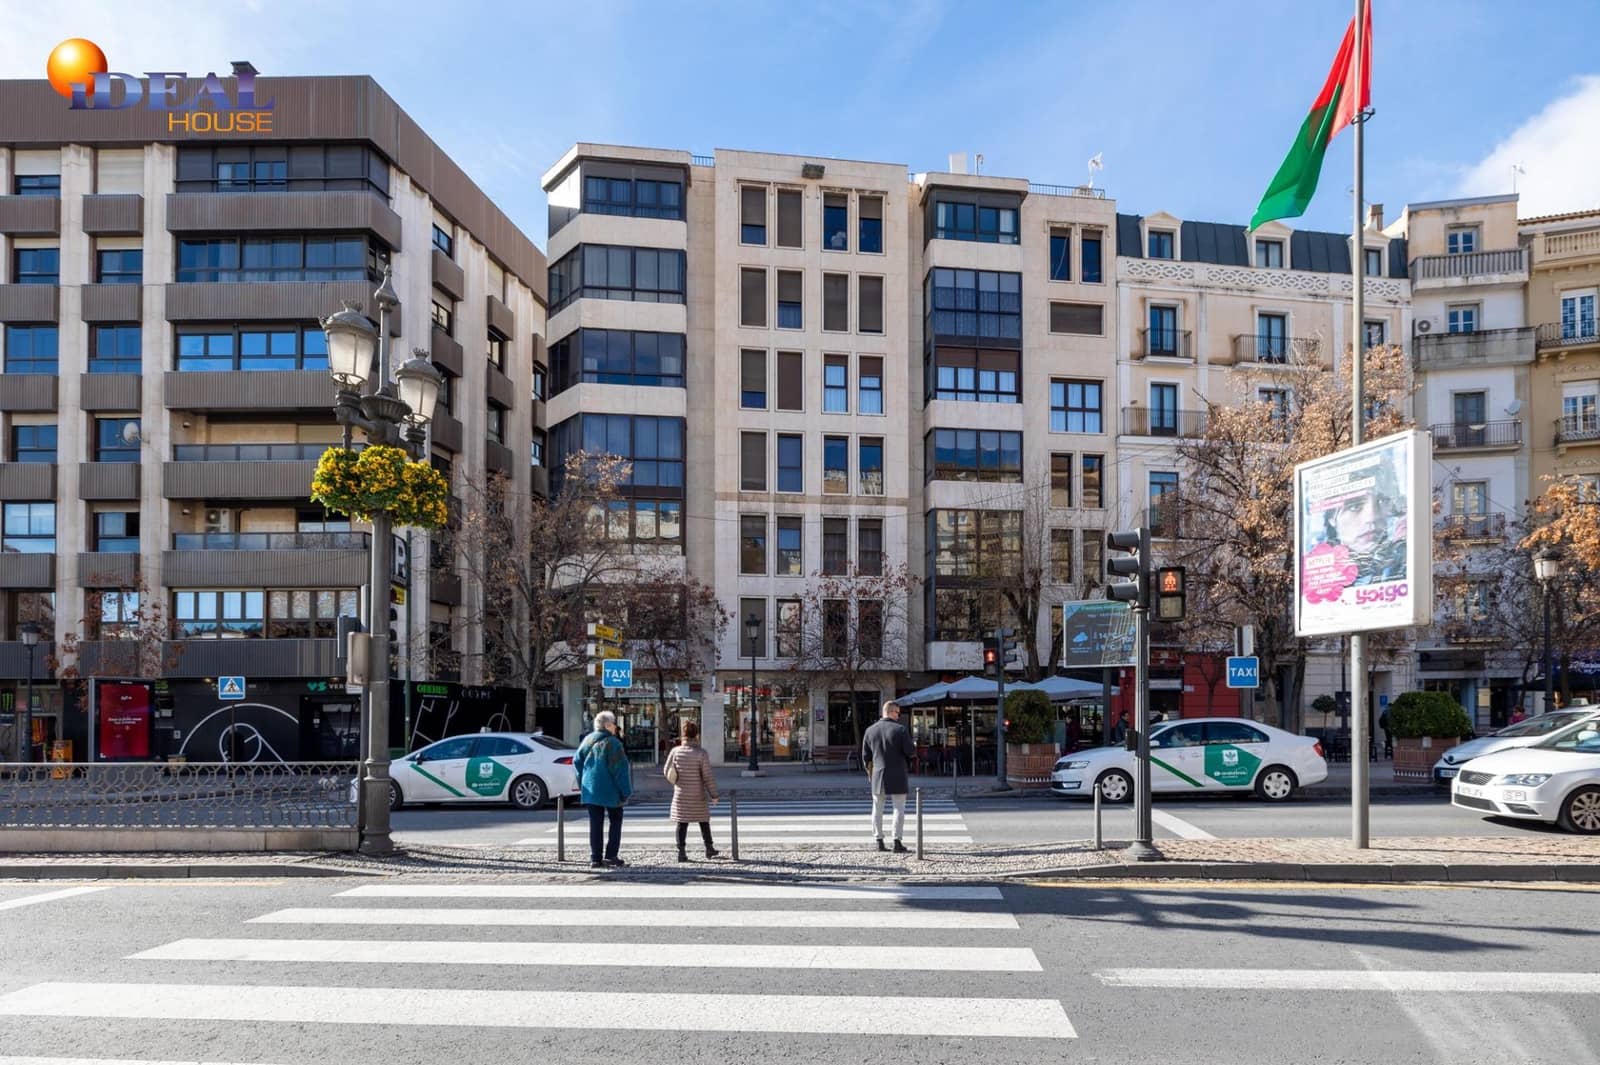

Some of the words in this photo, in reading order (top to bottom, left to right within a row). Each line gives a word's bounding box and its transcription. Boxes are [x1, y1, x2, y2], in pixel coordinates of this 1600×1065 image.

[1355, 583, 1408, 605] yoigo
[604, 668, 631, 678] TAXI
[1230, 667, 1257, 677] TAXI
